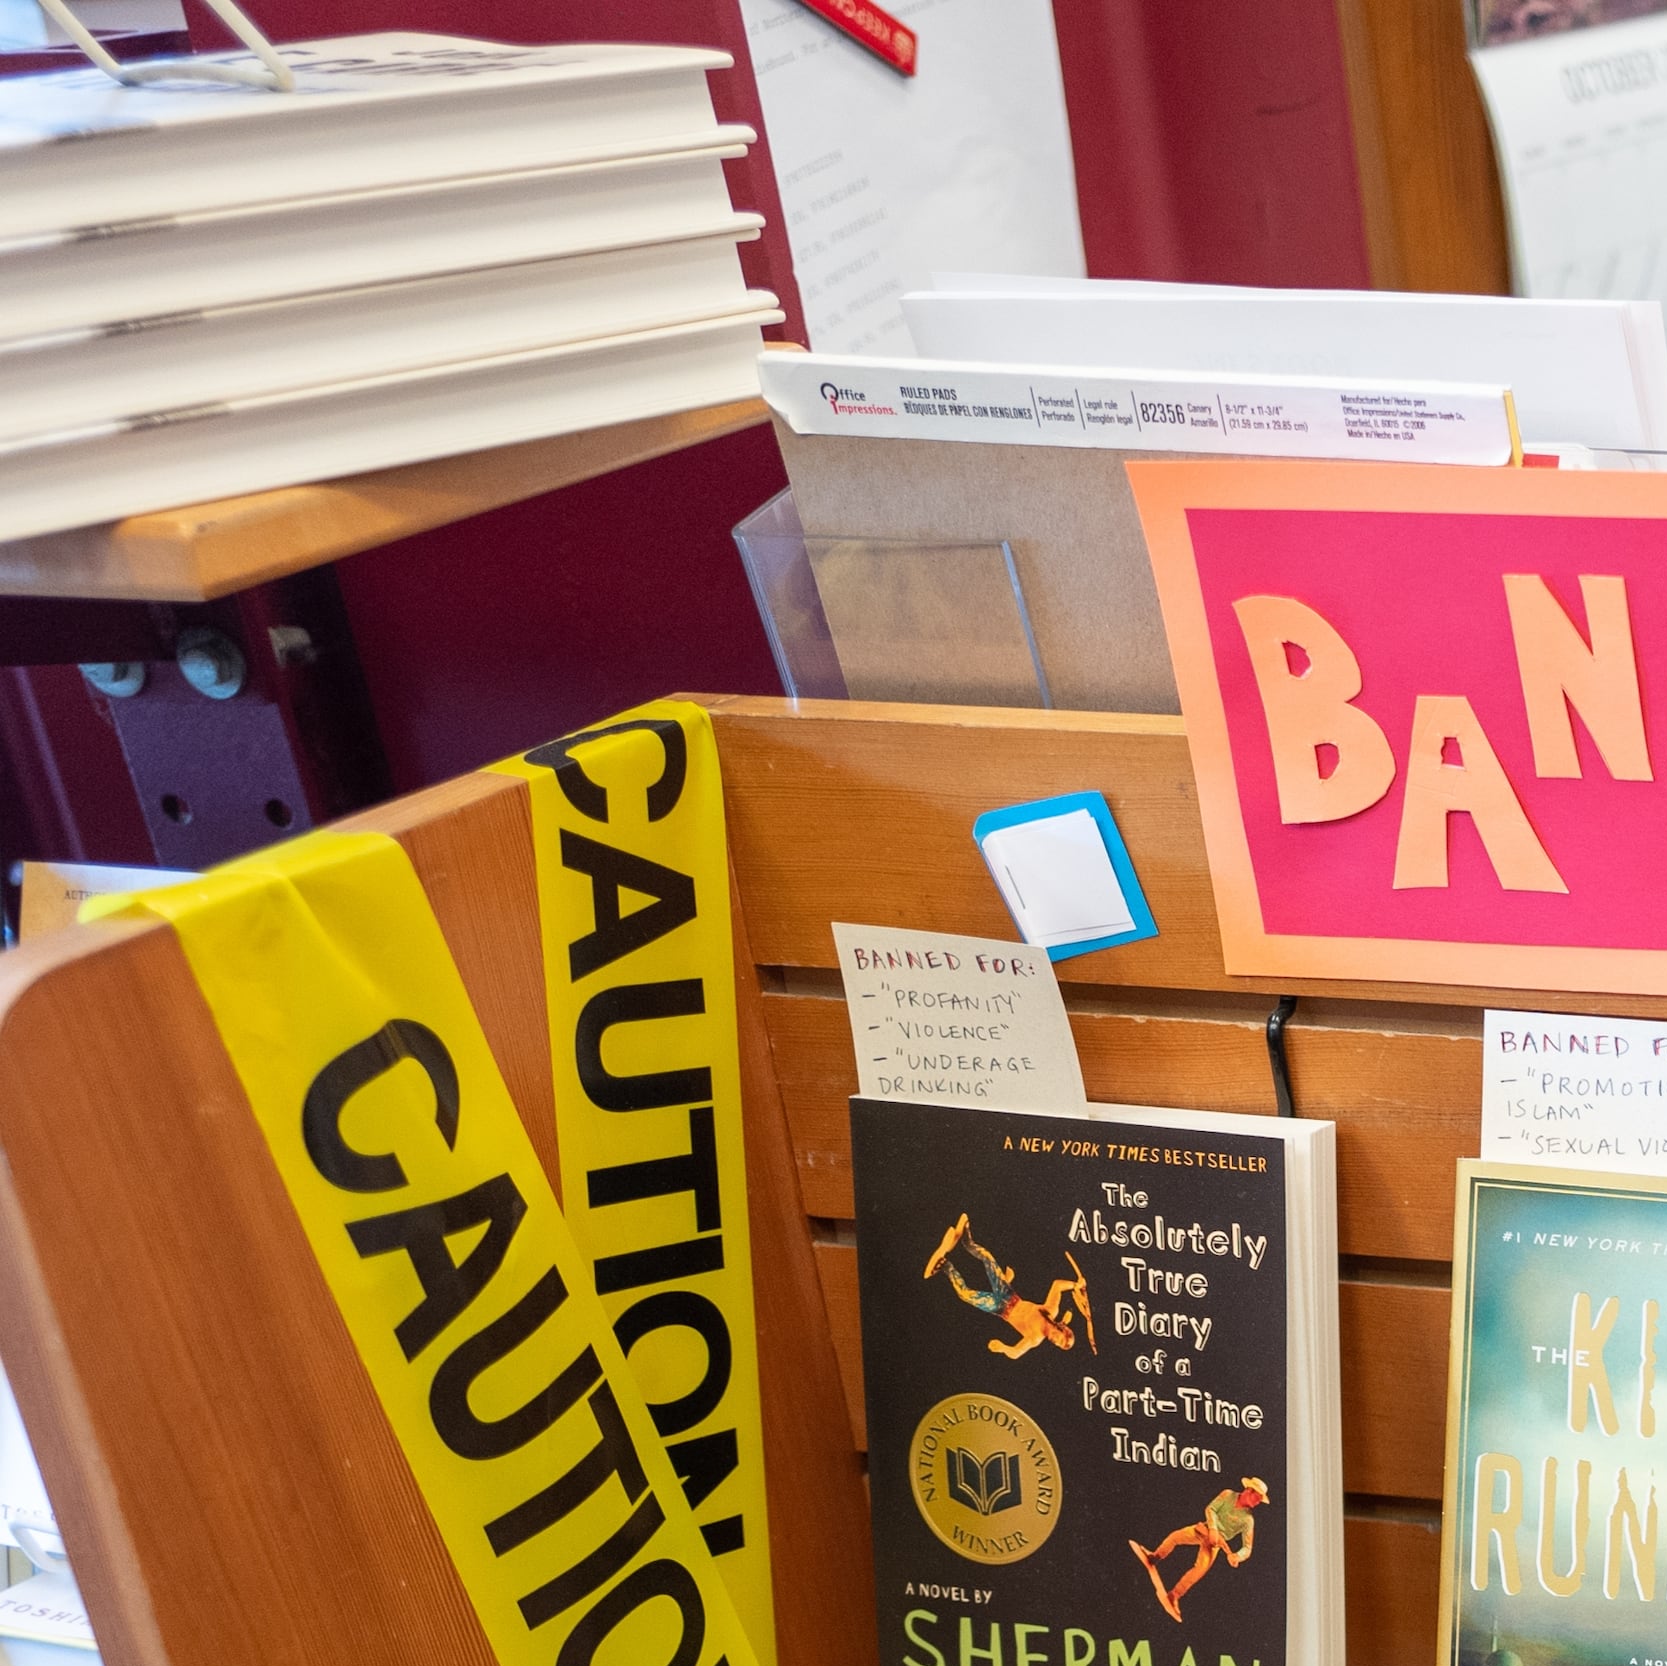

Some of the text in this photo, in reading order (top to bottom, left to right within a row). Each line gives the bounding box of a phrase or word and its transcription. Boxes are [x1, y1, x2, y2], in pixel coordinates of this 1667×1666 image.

[820, 382, 866, 401] Office
[900, 386, 957, 401] RULED PADS
[973, 406, 989, 418] CON
[991, 406, 1032, 420] RENGLONES
[1141, 401, 1185, 426] 82356
[854, 948, 1035, 977] BANNED FOR:
[1500, 1032, 1630, 1056] BANNED
[1003, 1136, 1267, 1173] A NEW YORK TIMES BESTSELLER
[1101, 1182, 1149, 1209] The
[1069, 1208, 1267, 1270] Absolutely
[1502, 1231, 1522, 1244] #1
[1533, 1233, 1580, 1249] NEW
[1588, 1236, 1641, 1254] YORK
[1121, 1258, 1208, 1297] True
[1114, 1303, 1212, 1351] Diary
[1135, 1349, 1190, 1376] of a
[1532, 1346, 1590, 1367] THE
[1083, 1377, 1264, 1429] Part-Time
[918, 1403, 1054, 1516] NATIONAL BOOK AWARD
[1111, 1428, 1220, 1473] Indian
[952, 1525, 1030, 1556] WINNER
